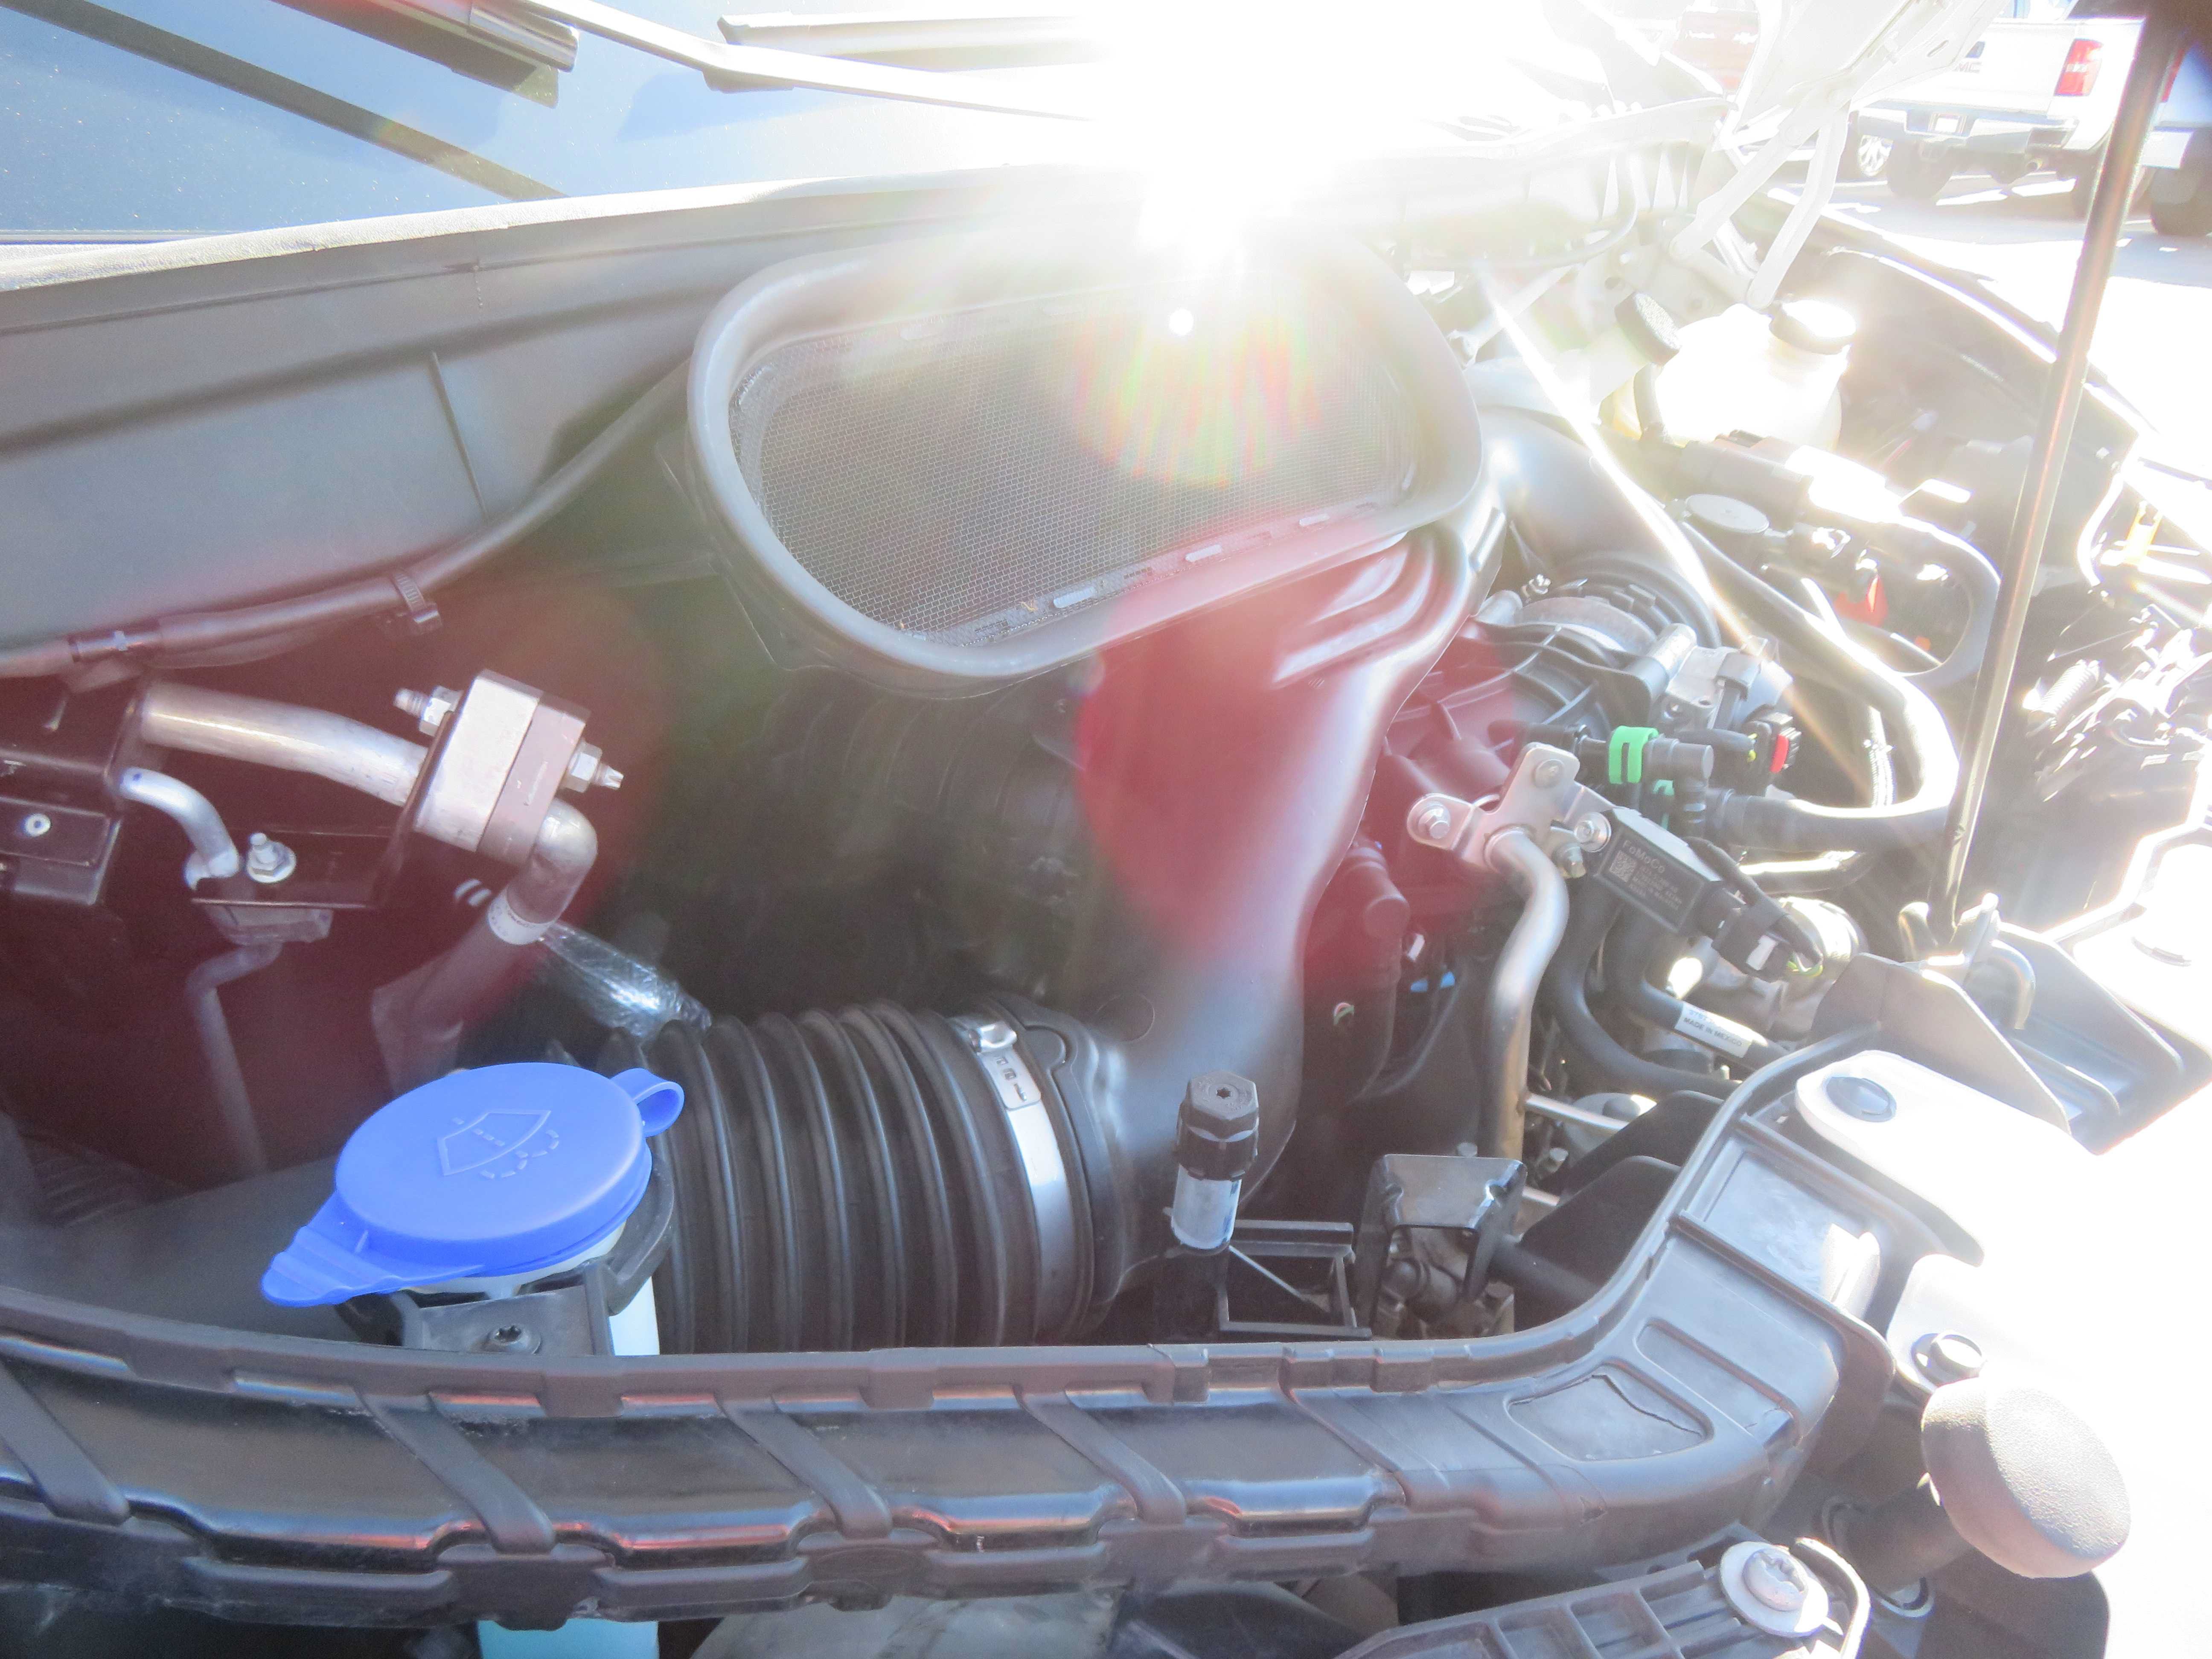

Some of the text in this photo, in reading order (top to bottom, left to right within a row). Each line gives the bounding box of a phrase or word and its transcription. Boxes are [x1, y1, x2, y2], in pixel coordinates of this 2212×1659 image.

[1954, 61, 1982, 73] MC
[1623, 839, 1665, 873] FoMoCo
[1683, 1017, 1742, 1046] MADE IN MEXICO
